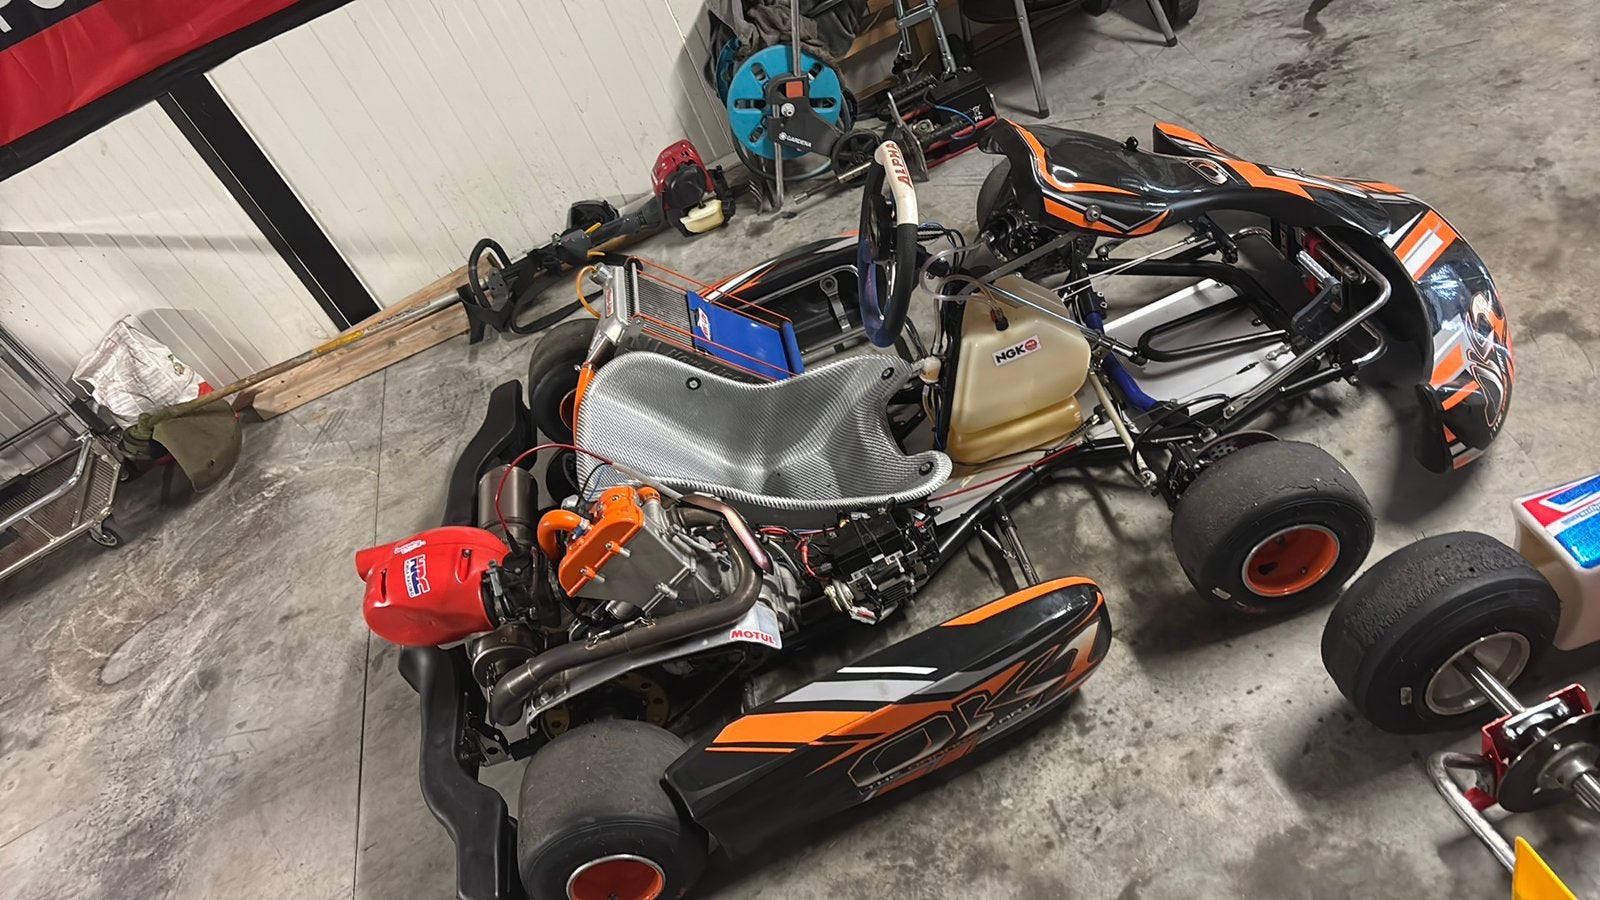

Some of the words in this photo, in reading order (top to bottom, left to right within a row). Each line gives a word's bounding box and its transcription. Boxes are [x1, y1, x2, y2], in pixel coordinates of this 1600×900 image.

[786, 134, 812, 148] GARDENA
[885, 143, 913, 189] ALPHA
[994, 344, 1026, 364] NGK
[410, 555, 430, 595] HRC
[731, 629, 775, 644] MOTUL
